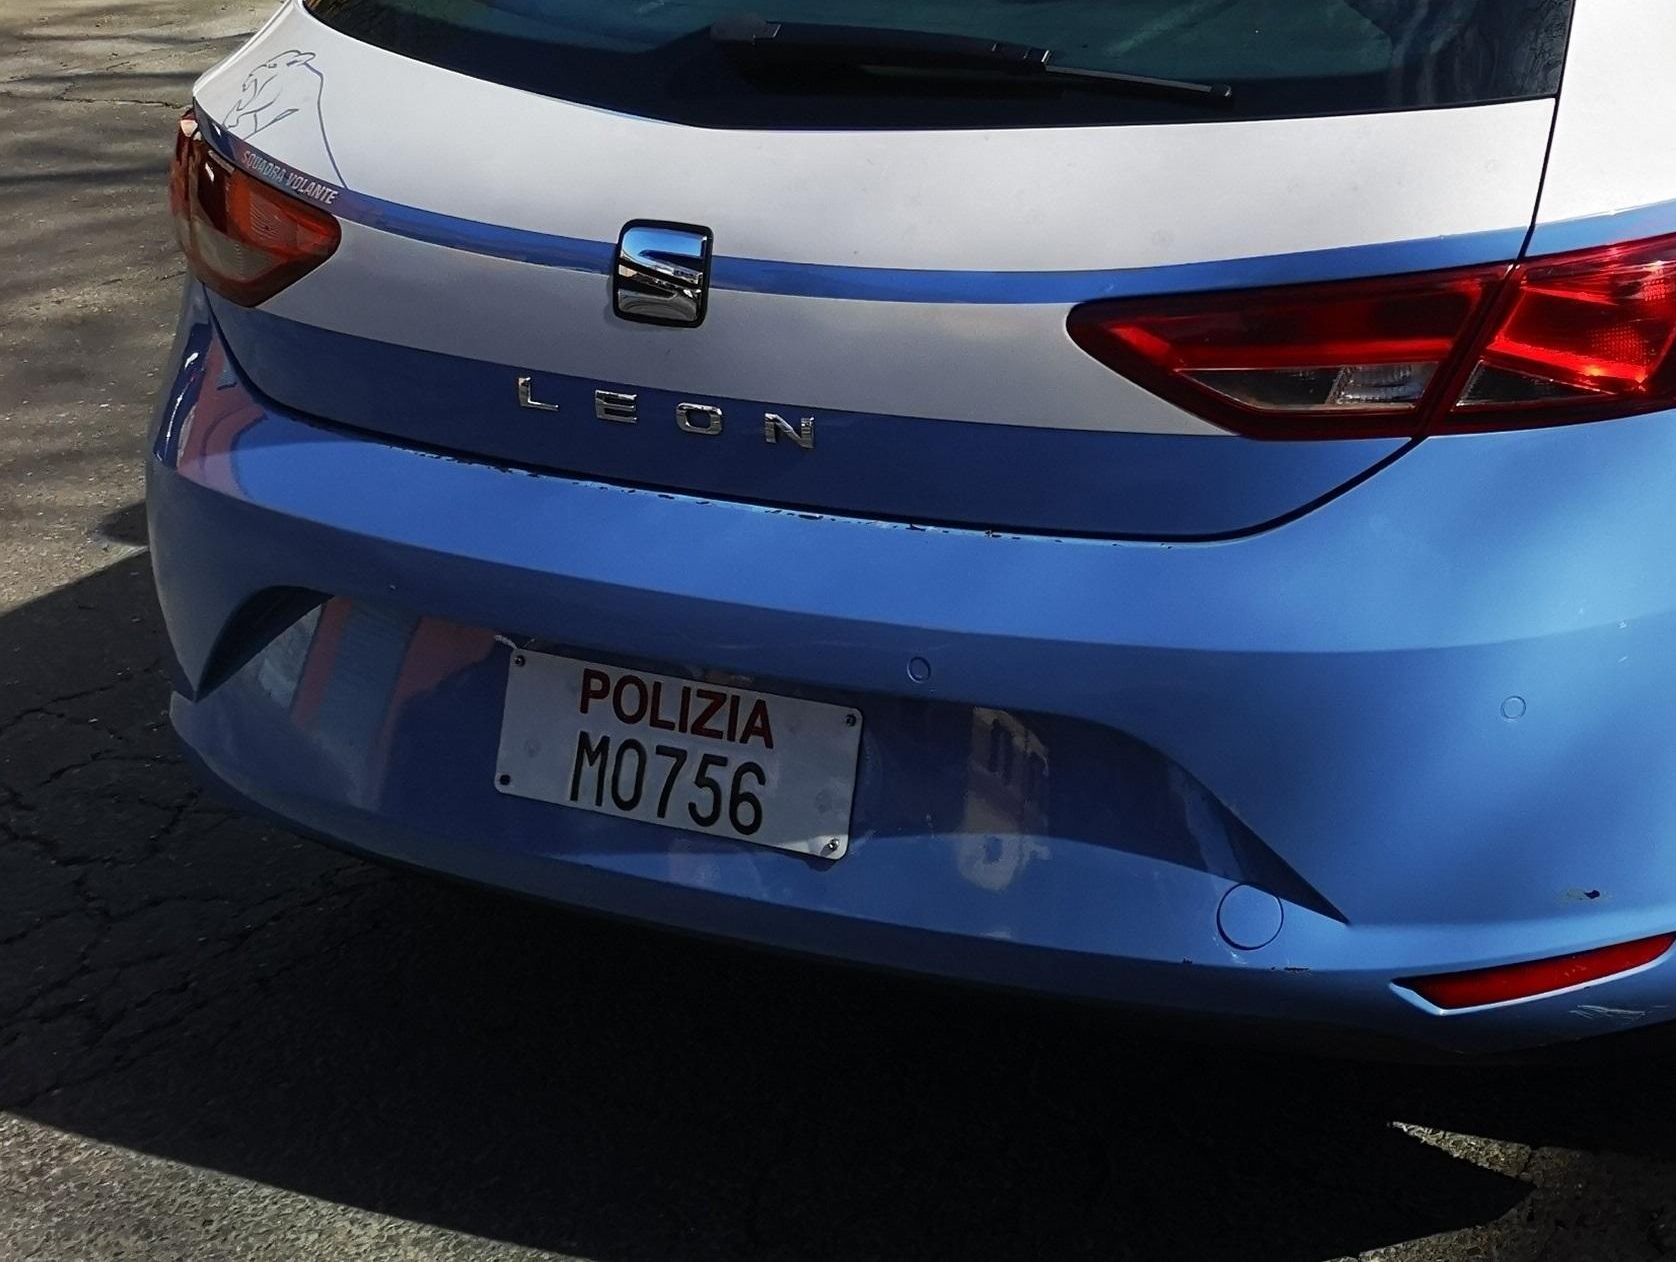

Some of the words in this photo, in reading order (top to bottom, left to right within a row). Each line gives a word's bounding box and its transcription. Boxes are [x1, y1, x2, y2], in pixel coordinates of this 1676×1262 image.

[241, 150, 284, 184] SQUADRA
[287, 172, 339, 205] VOLANTE
[517, 376, 815, 450] LEON
[579, 668, 775, 750] POLIZIA
[569, 730, 767, 837] M0756
